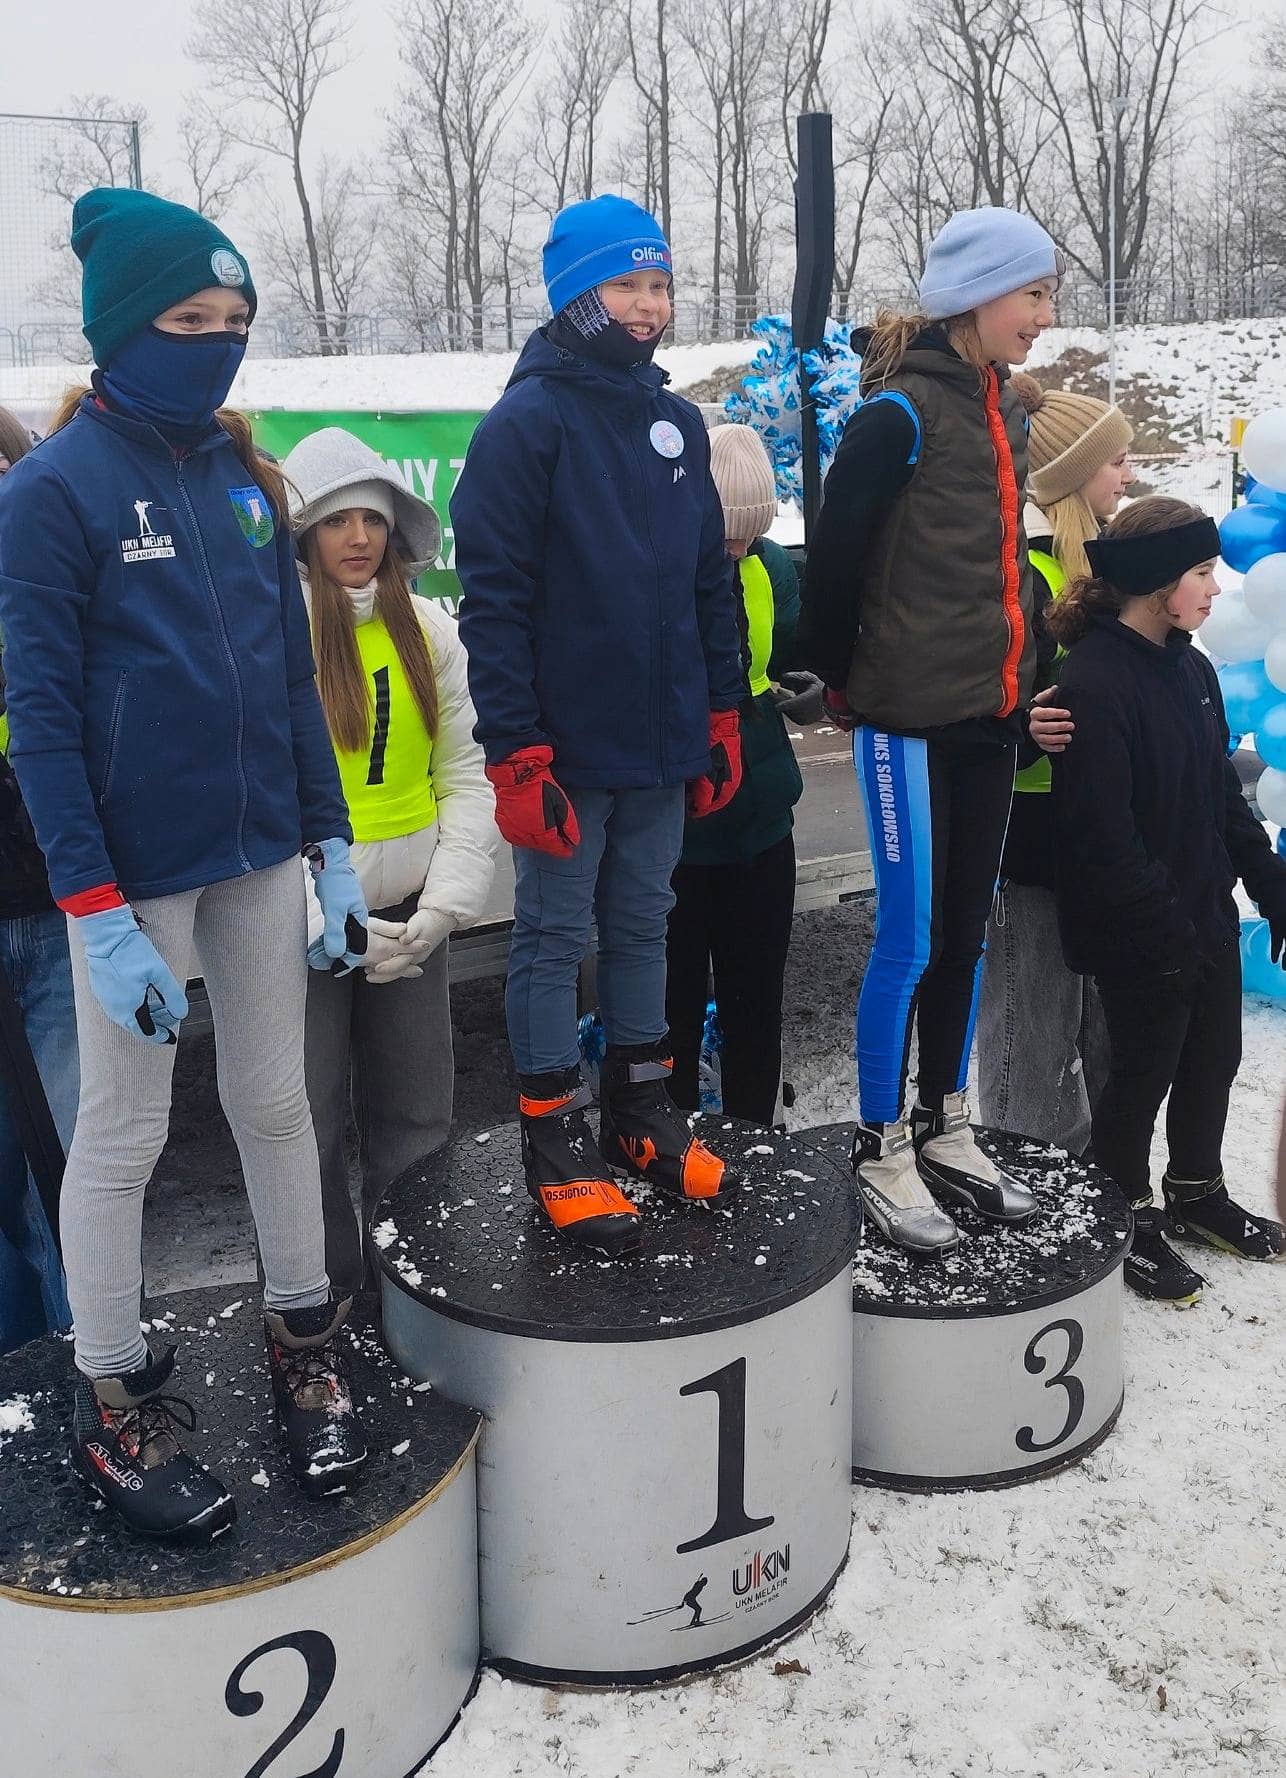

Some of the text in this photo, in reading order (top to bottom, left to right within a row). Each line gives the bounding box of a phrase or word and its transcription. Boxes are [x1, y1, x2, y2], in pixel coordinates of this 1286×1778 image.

[873, 733, 901, 863] UKS SOKOŁOWSKO
[862, 1187, 903, 1226] ATOMIC
[1015, 1318, 1085, 1453] 3
[676, 1356, 775, 1555] 1
[735, 1577, 788, 1609] UKN MELAFIR
[225, 1629, 345, 1778] 2
